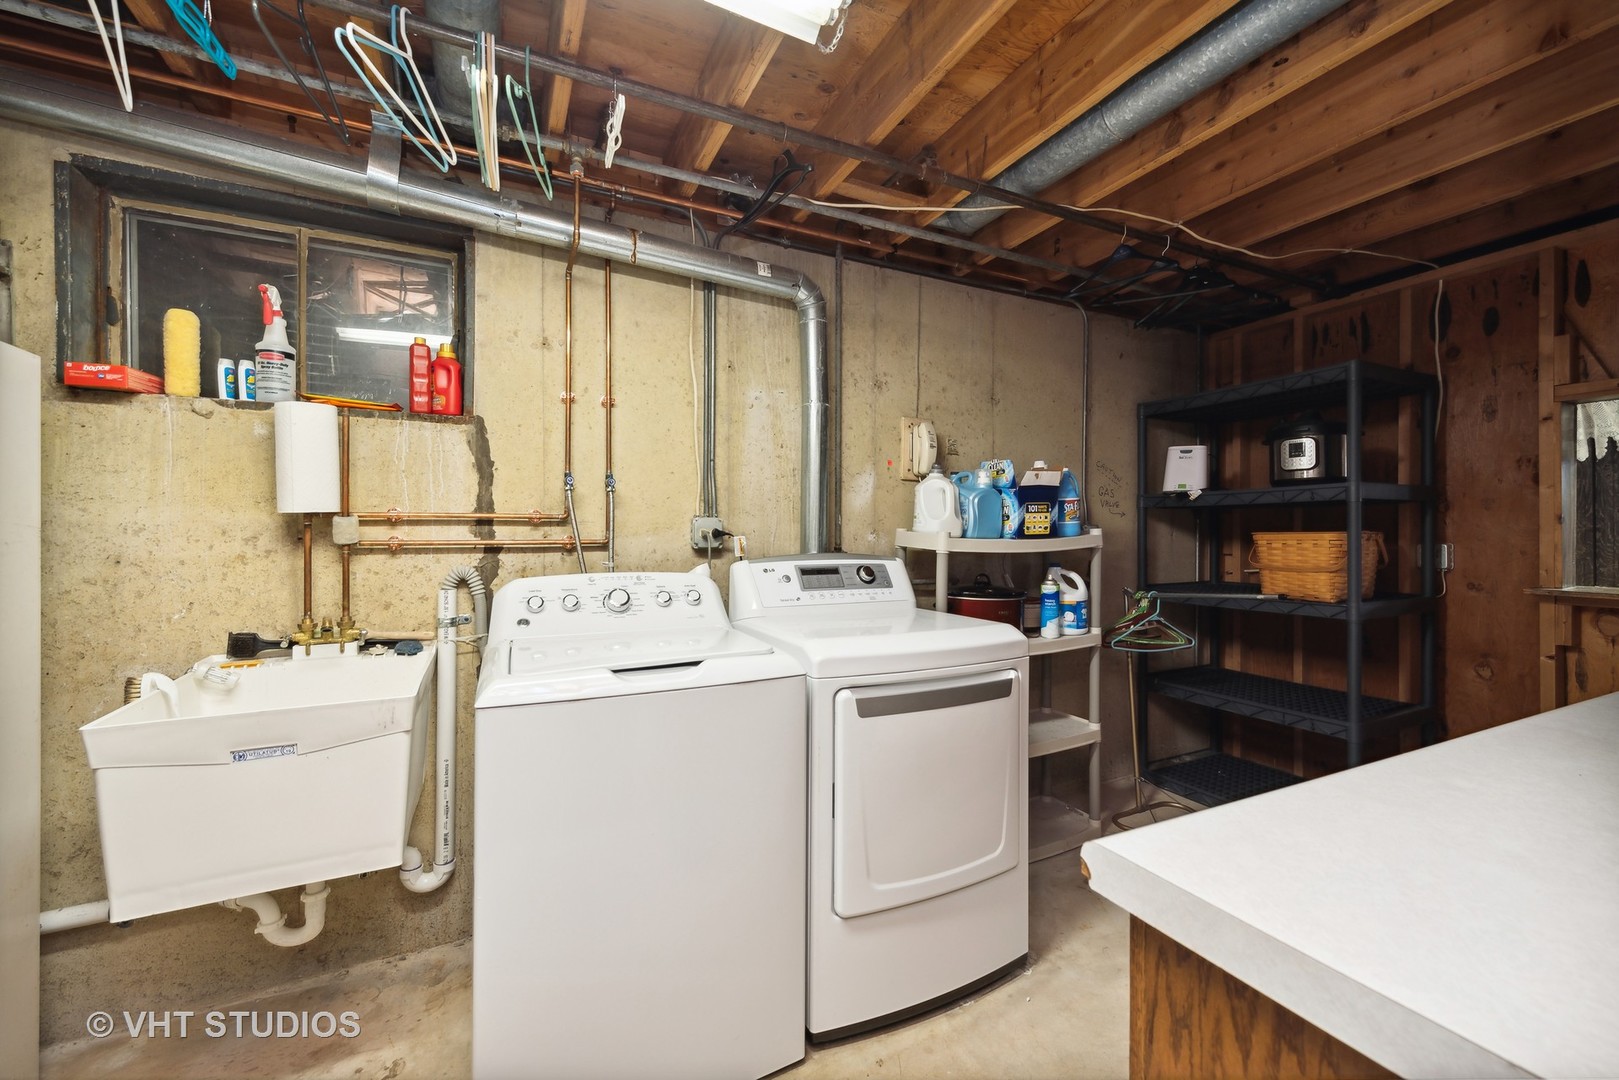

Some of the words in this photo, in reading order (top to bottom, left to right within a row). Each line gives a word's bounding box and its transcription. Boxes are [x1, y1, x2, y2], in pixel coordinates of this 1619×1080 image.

[83, 364, 111, 372] bounce
[1098, 485, 1115, 499] GAS
[1028, 504, 1038, 513] 101
[1100, 499, 1120, 509] VALVE
